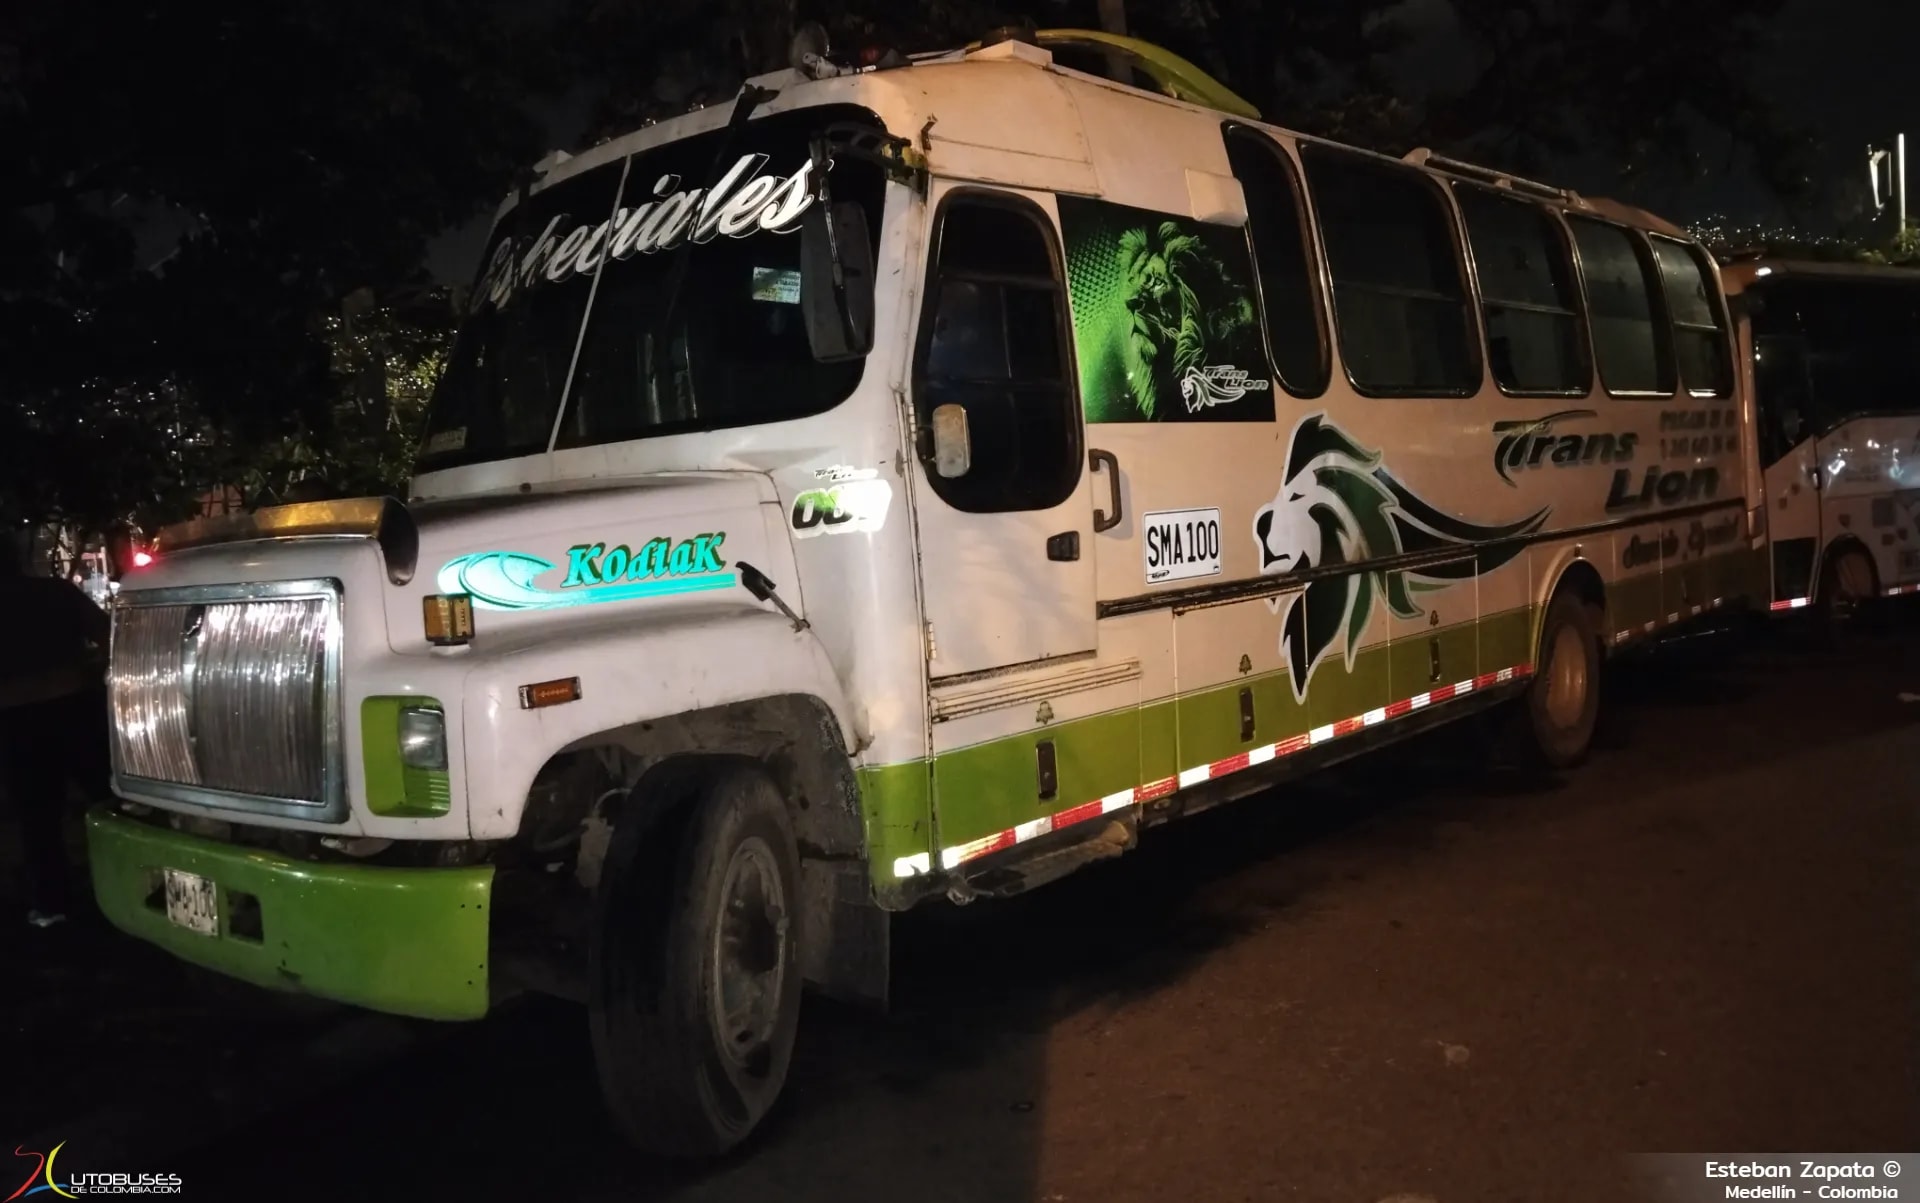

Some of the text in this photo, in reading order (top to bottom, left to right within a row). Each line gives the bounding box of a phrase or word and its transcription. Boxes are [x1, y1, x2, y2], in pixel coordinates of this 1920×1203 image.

[1492, 409, 1638, 488] Trans
[1605, 464, 1719, 513] Lion
[1147, 519, 1219, 568] SMA100
